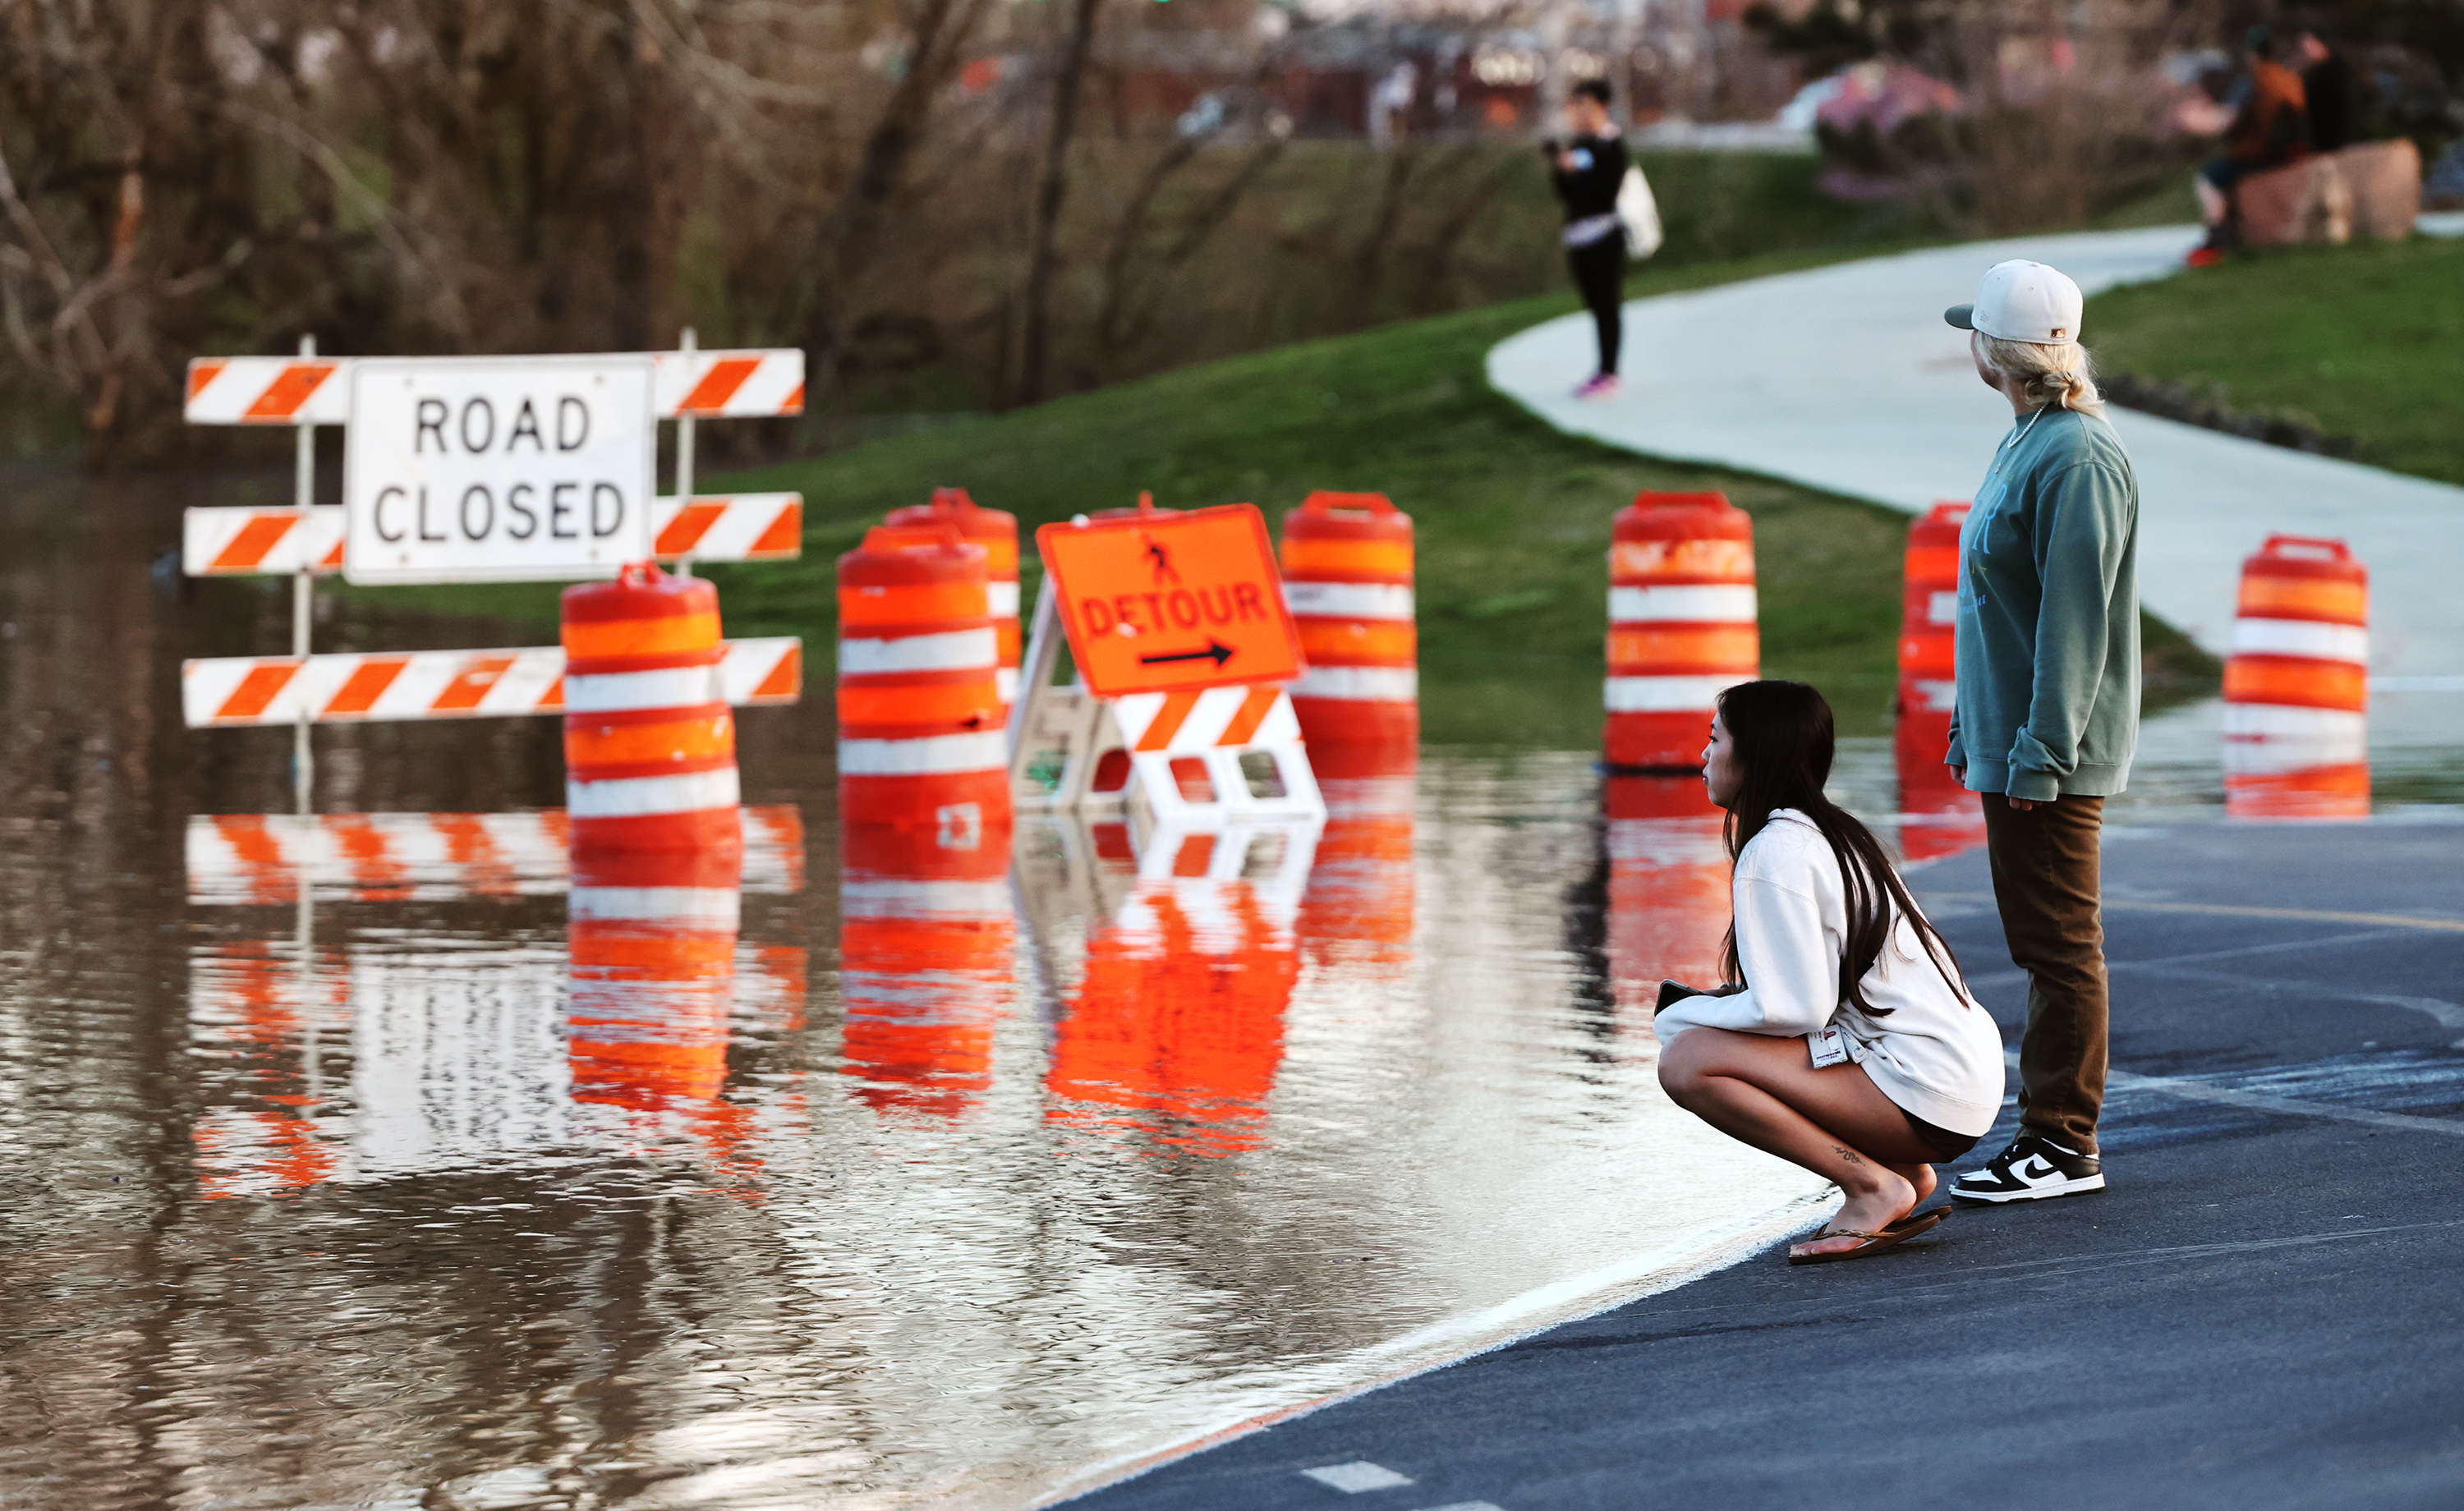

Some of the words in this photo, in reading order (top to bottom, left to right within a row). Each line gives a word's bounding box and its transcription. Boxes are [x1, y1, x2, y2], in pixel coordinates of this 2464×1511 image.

[416, 395, 591, 453] ROAD
[374, 482, 625, 543] CLOSED
[1081, 583, 1266, 636] DETOUR
